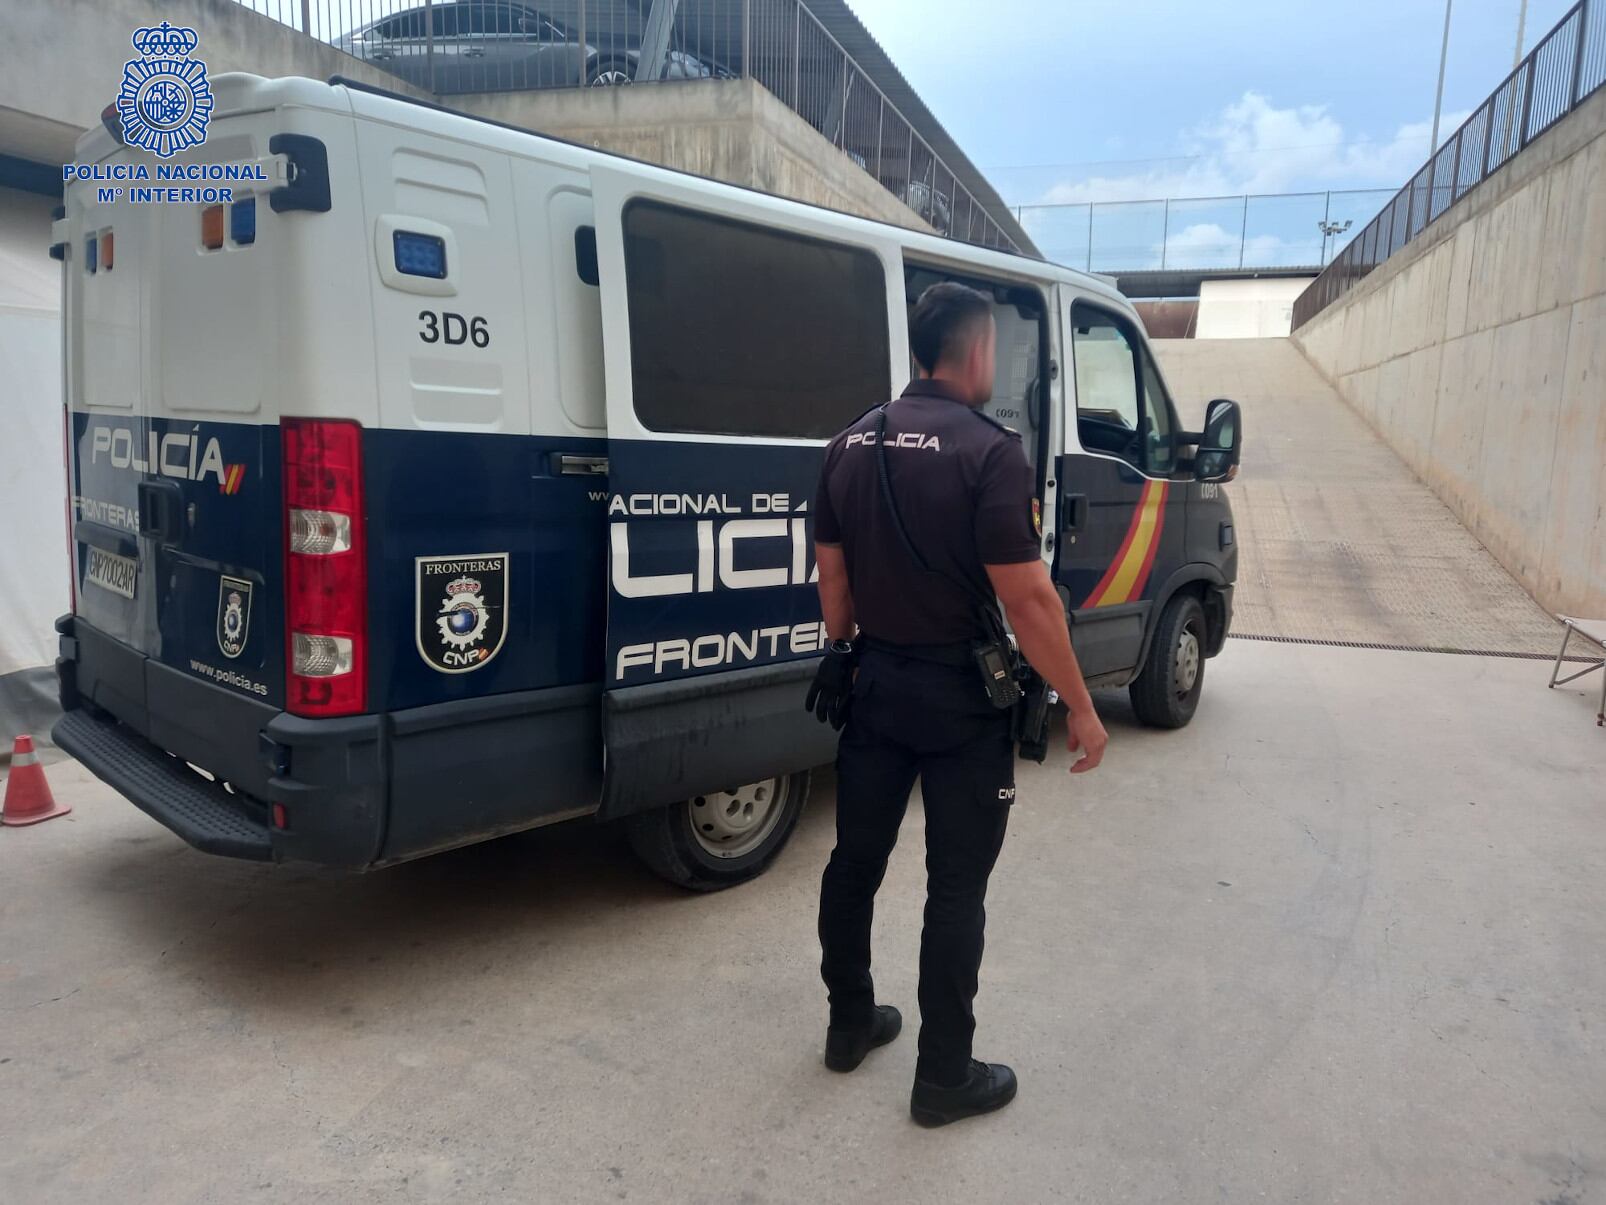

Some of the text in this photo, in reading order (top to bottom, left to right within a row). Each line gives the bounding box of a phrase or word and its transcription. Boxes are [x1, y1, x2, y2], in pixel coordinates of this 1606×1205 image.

[418, 310, 490, 348] 3D6
[92, 424, 226, 486] POLICÍA
[609, 493, 790, 516] ACIONAL DE
[425, 560, 501, 575] FRONTERAS
[611, 500, 820, 598] LICÍ
[189, 657, 268, 696] www.policia.es
[443, 649, 480, 666] CNP
